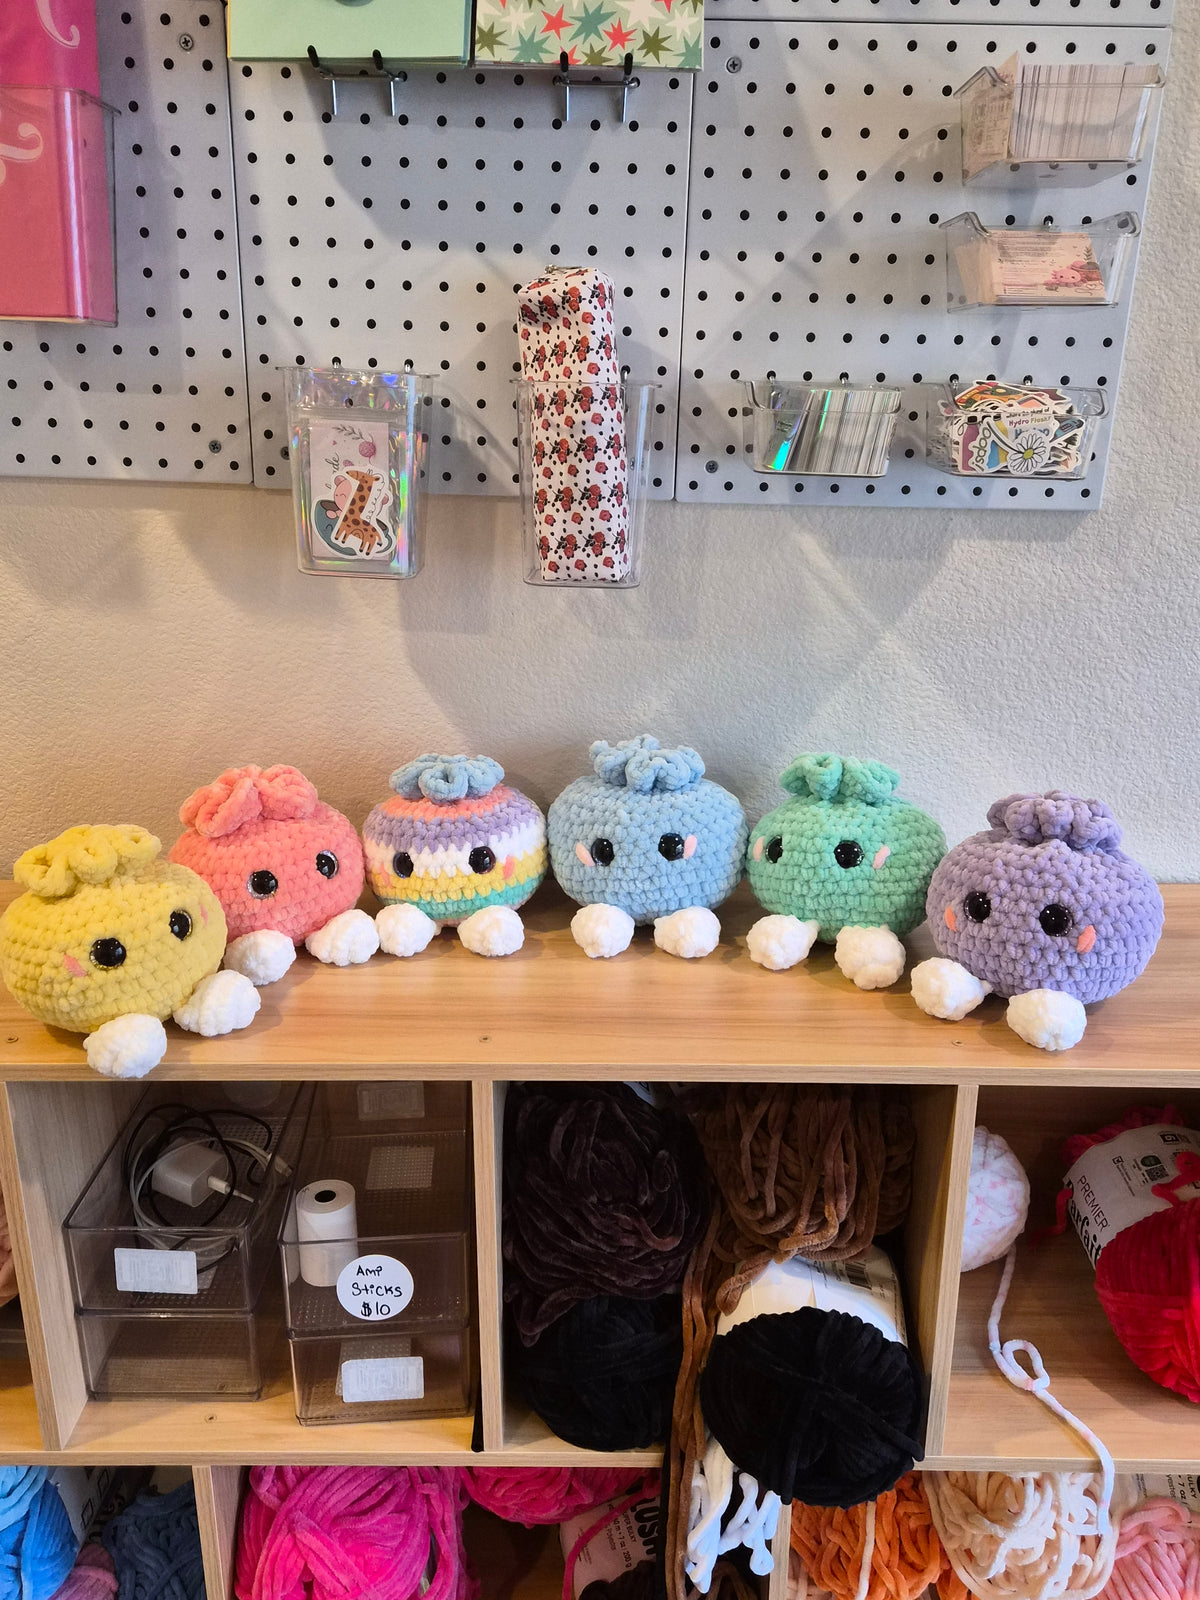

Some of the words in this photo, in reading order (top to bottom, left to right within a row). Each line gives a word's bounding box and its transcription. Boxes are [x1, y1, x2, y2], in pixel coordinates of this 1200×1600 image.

[1009, 419, 1030, 428] Hydro
[1078, 1175, 1109, 1232] PREMIER
[360, 1301, 391, 1317] $10
